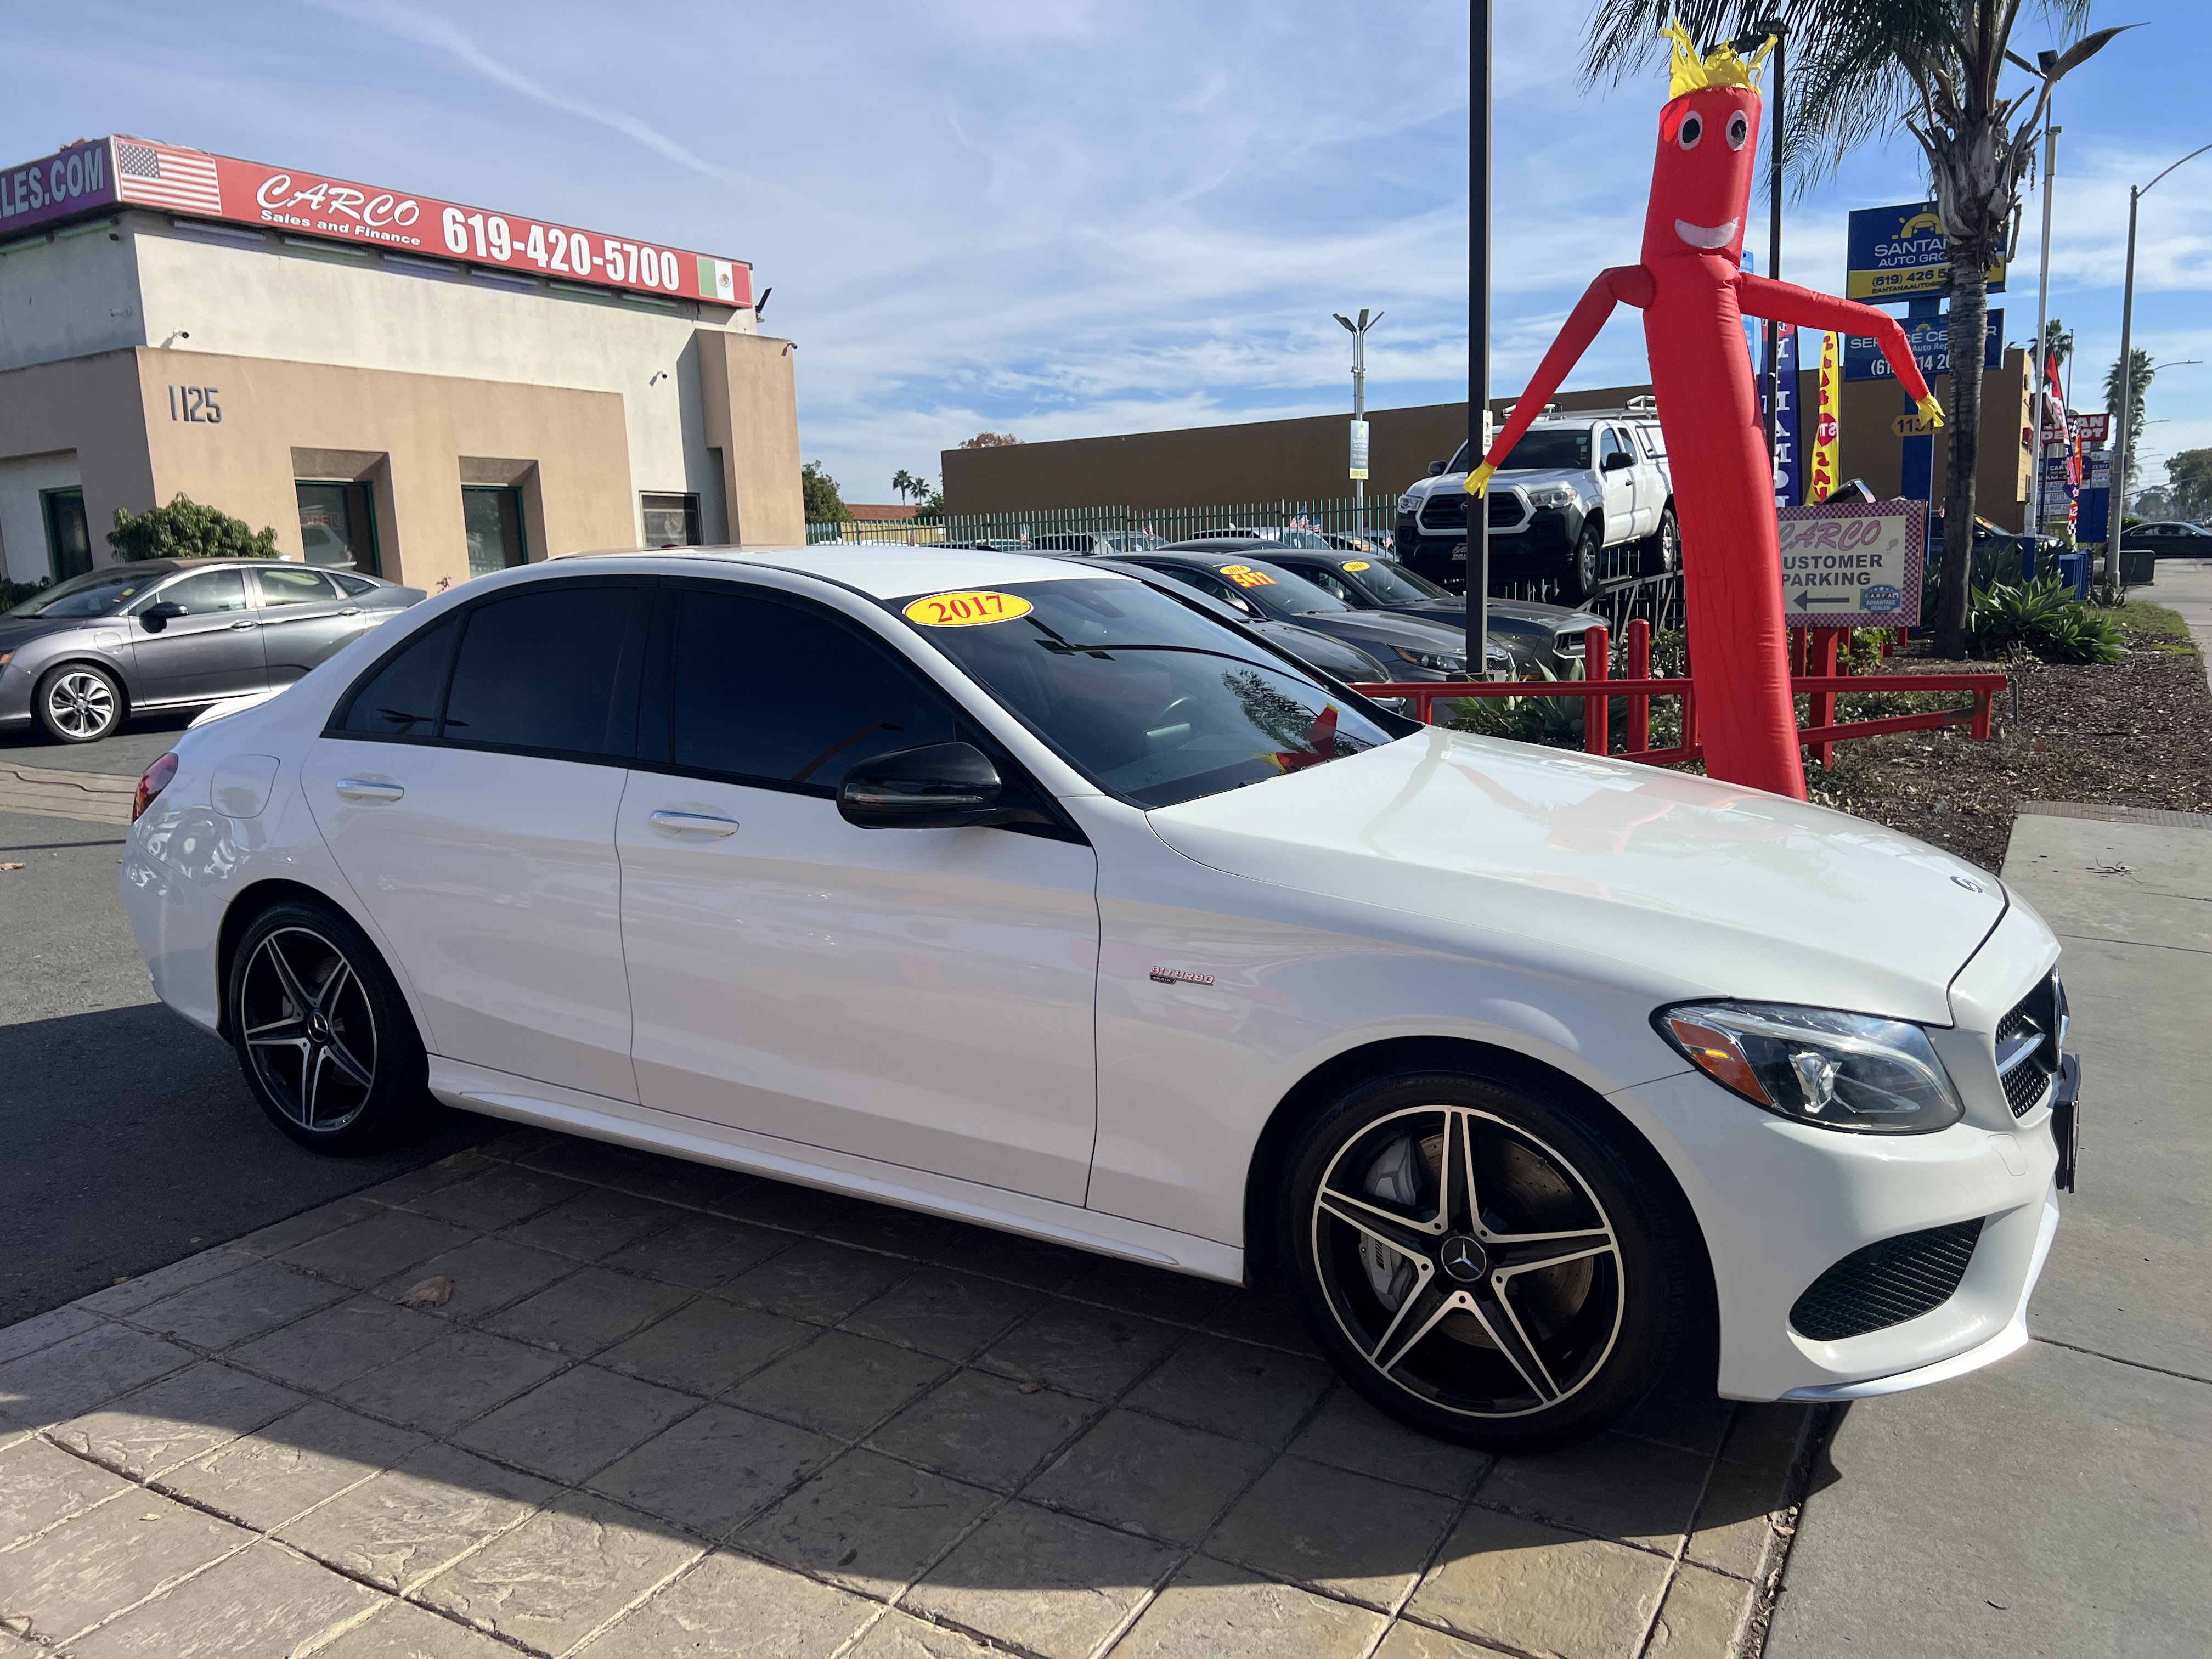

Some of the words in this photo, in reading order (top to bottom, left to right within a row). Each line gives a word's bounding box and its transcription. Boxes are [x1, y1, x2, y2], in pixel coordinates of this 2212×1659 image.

[0, 147, 104, 218] LES.COM
[256, 174, 420, 227] CARCO
[261, 210, 311, 227] Sales
[317, 221, 349, 234] and
[355, 225, 421, 246] Finance
[443, 207, 680, 291] 619-420-5700
[1878, 254, 1916, 267] AUTO
[1919, 252, 1946, 262] GRO
[1872, 274, 1903, 287] (619)
[1906, 270, 1934, 281] 426
[1938, 268, 1949, 278] 5
[1934, 343, 1949, 351] Rep
[168, 385, 222, 423] 1125
[2041, 428, 2104, 441] DEOT
[1780, 520, 1881, 552] CARCO
[1784, 554, 1883, 569] USTOMER
[1782, 572, 1871, 587] PARKING
[929, 595, 1003, 623] 2017
[1150, 966, 1215, 984] BITURBO
